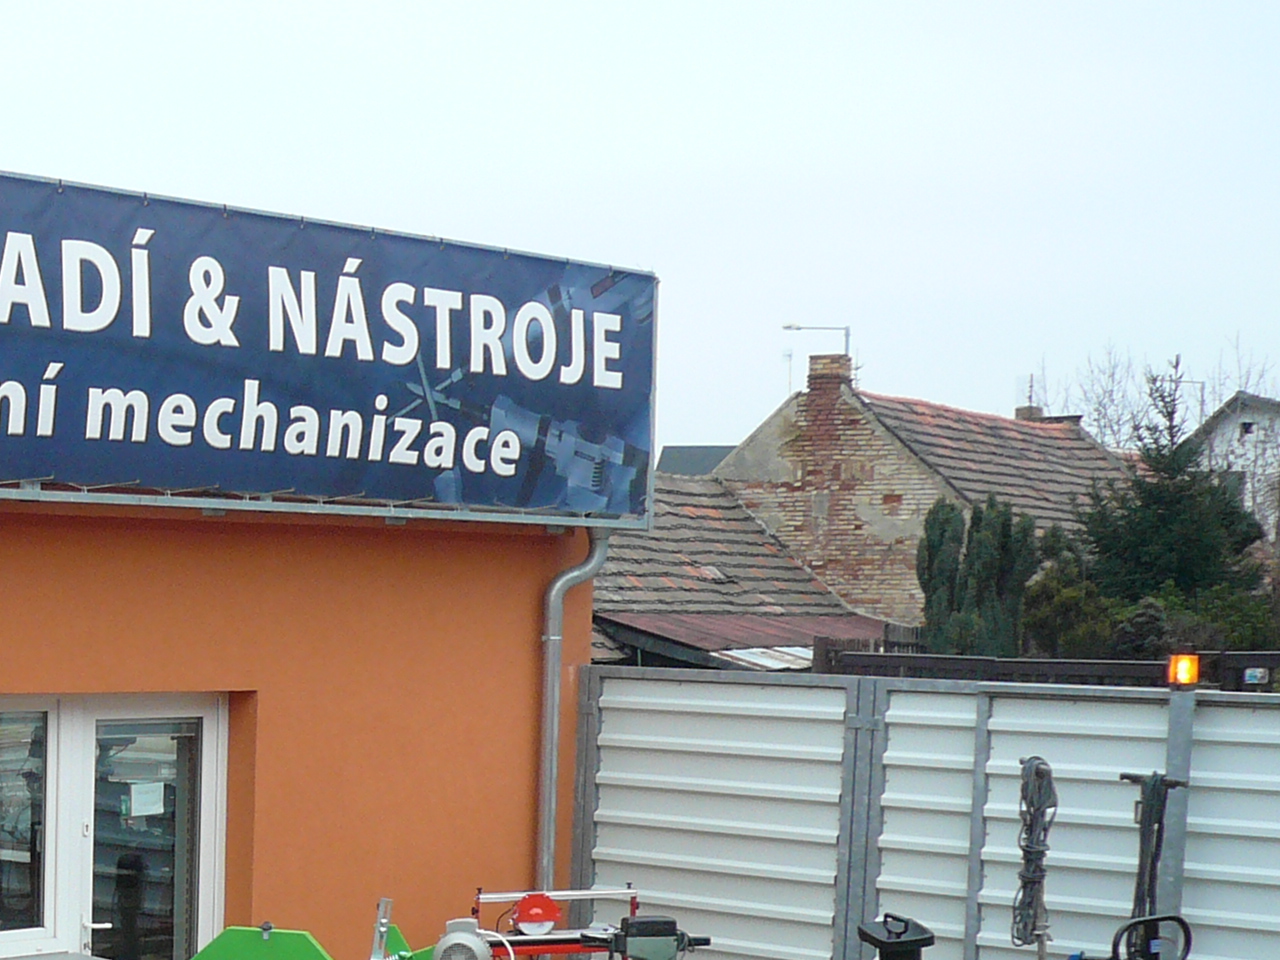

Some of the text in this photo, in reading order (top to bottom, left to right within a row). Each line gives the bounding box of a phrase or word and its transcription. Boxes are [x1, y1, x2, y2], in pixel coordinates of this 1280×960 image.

[182, 255, 241, 348] &
[267, 257, 623, 390] NÁSTROJE
[85, 379, 521, 477] mechanizace
